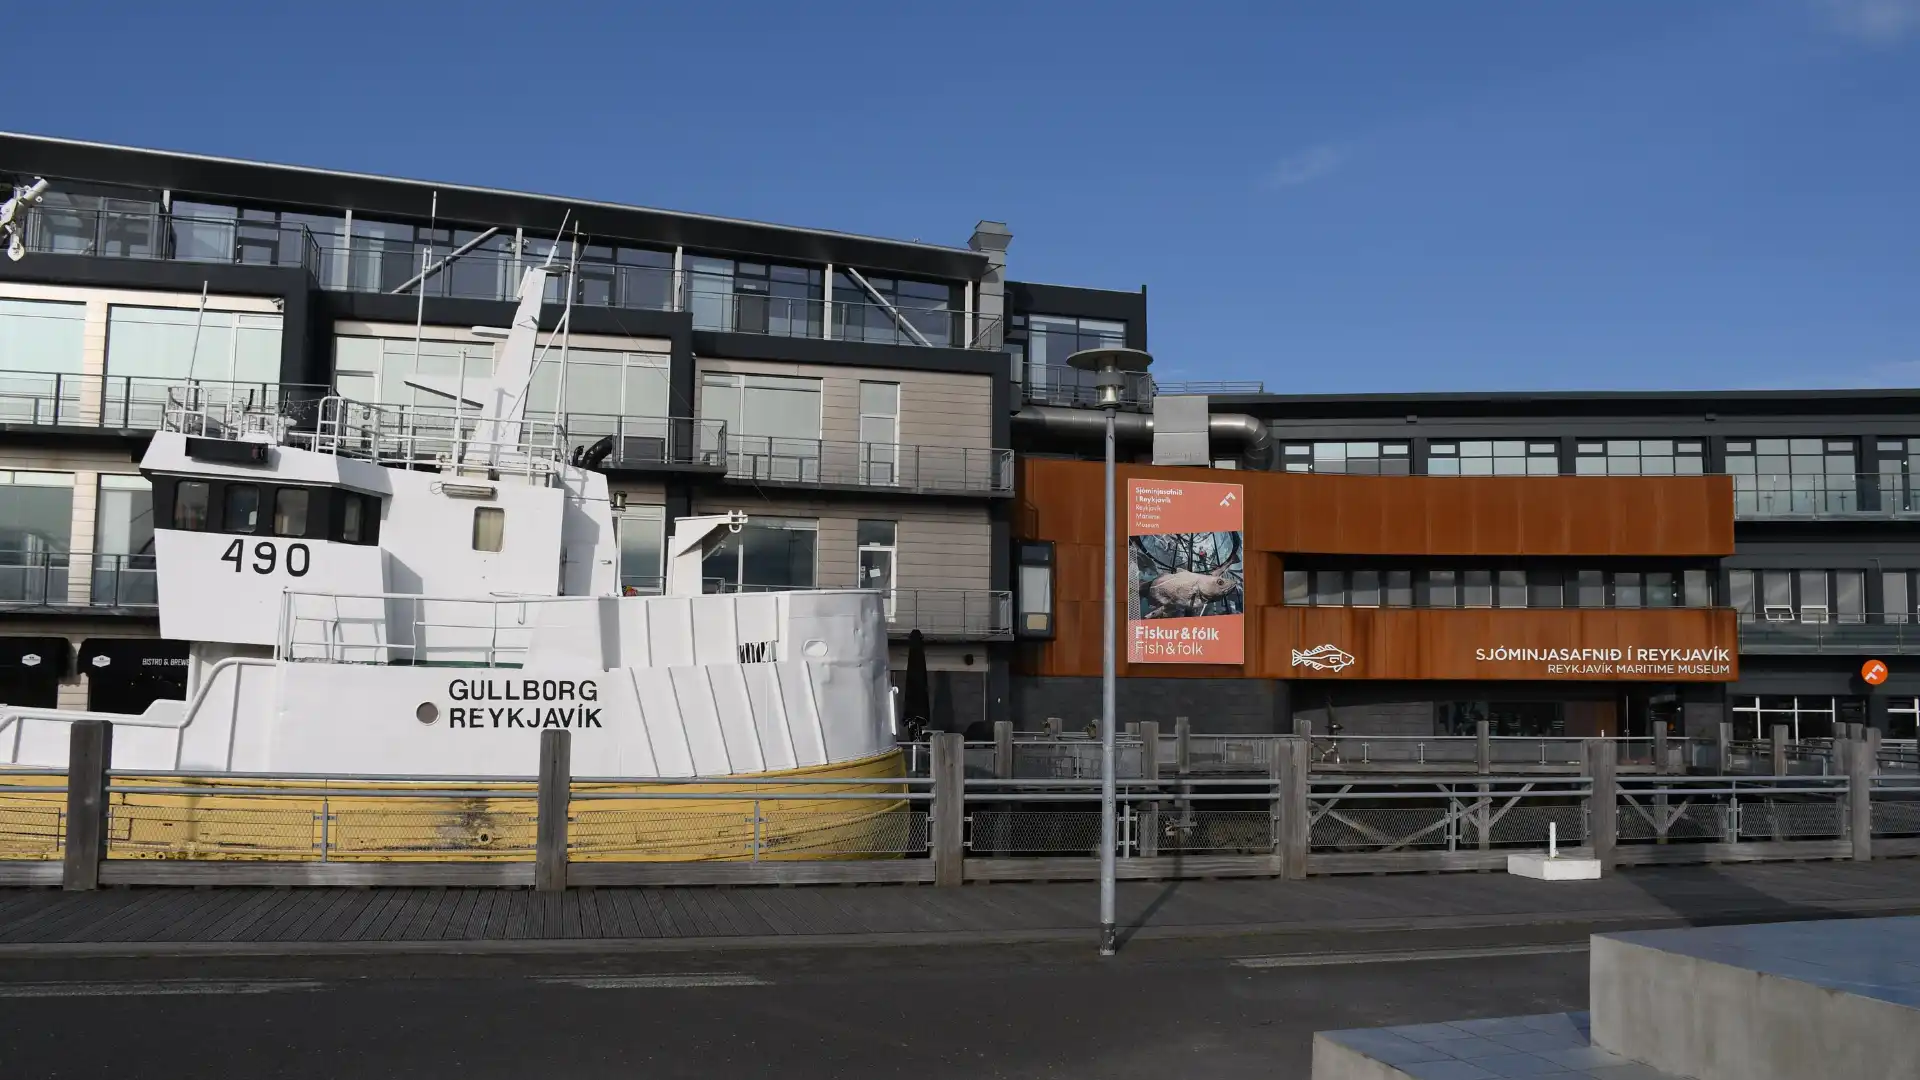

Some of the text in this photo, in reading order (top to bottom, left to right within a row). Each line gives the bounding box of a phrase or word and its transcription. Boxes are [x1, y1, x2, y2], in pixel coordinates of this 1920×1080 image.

[221, 538, 310, 577] 490
[1135, 626, 1180, 640] Fiskur
[1192, 627, 1220, 641] fólk
[1135, 641, 1164, 655] Fish
[1177, 641, 1204, 655] folk
[1476, 645, 1622, 661] SJÓMINJASAFNIÐ
[1637, 645, 1731, 661] REYKJAVÍK
[142, 658, 163, 666] BISTRO
[1547, 662, 1730, 674] REYKJAVÍK MARITIME MUSEUM
[449, 678, 598, 701] GULLBORG
[450, 703, 603, 728] REYKJAVÍK
